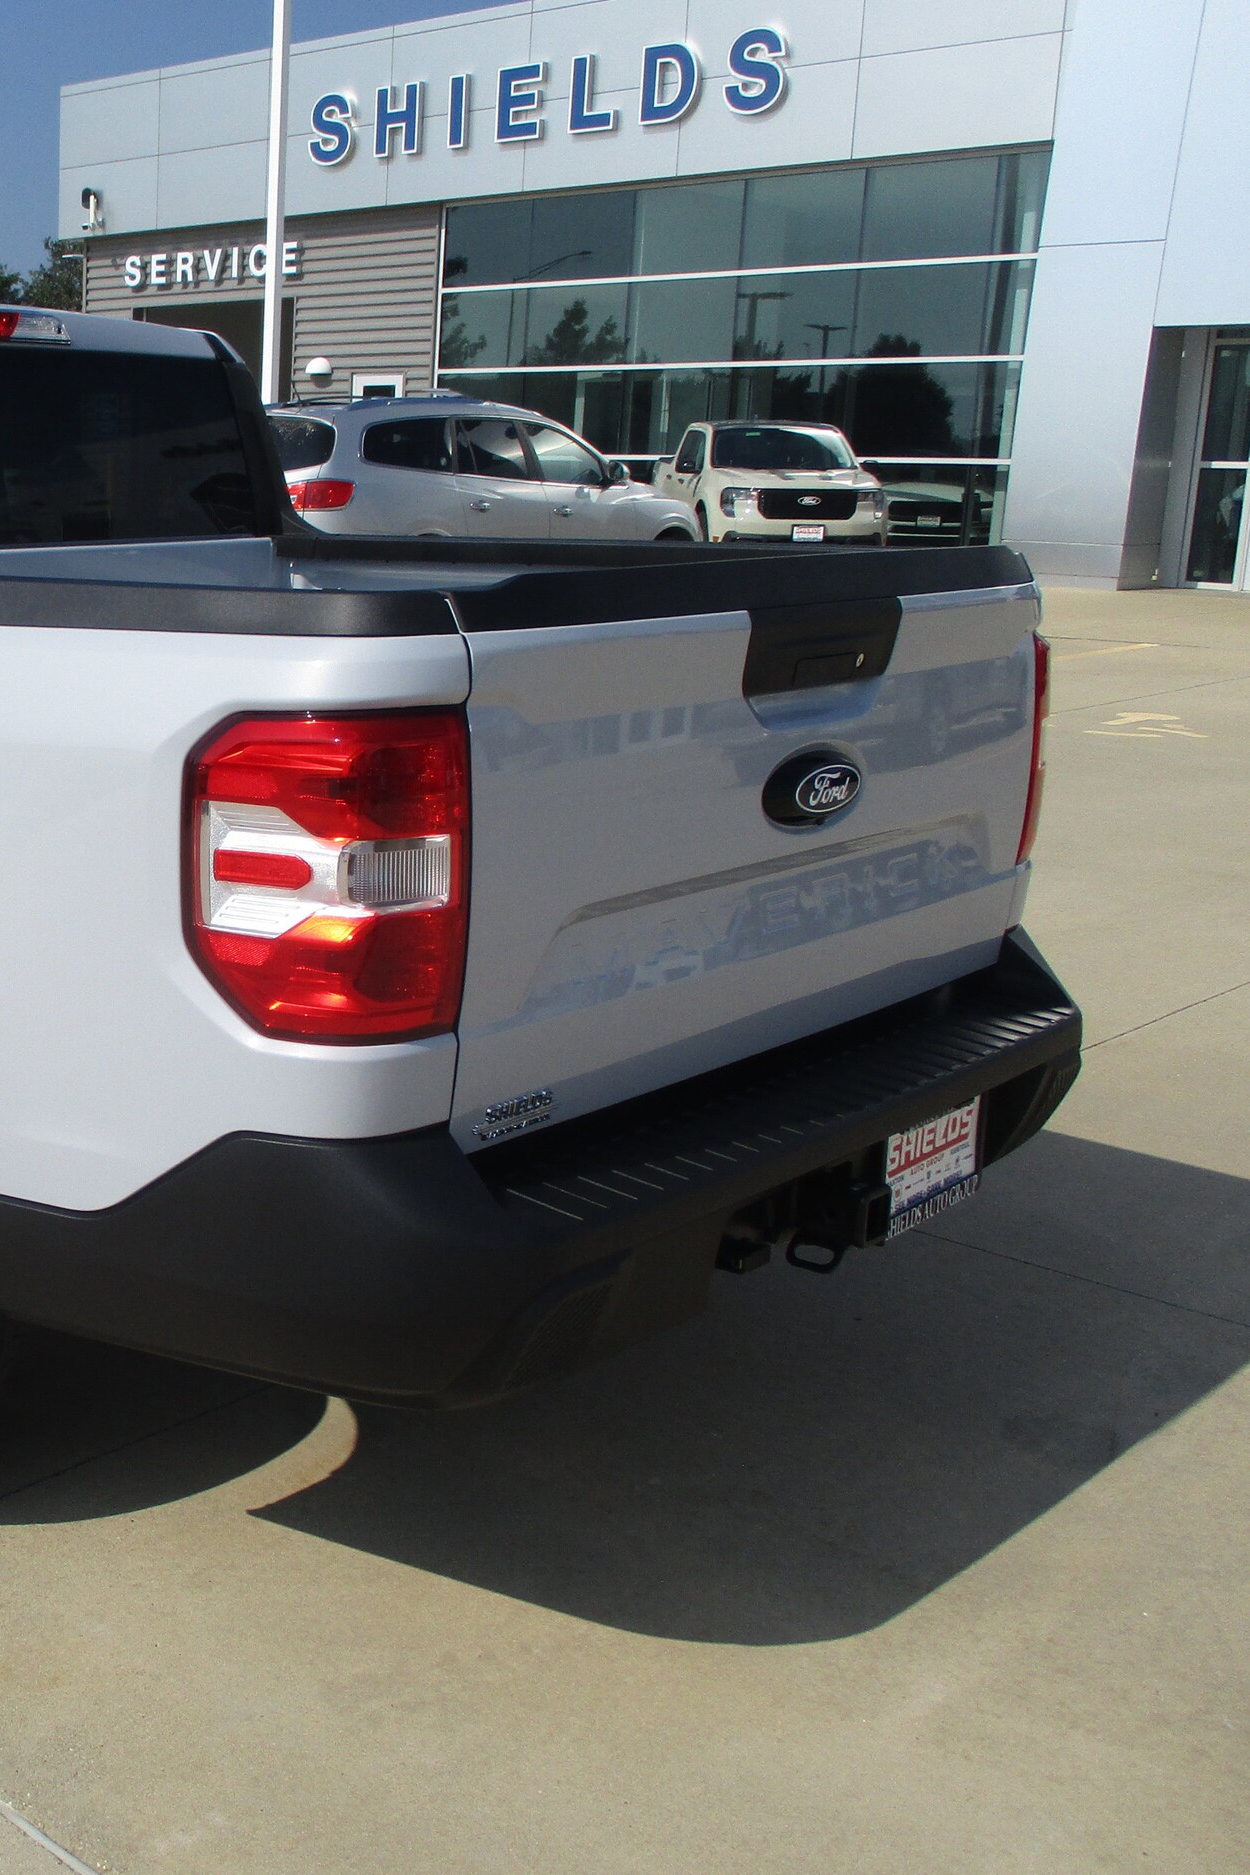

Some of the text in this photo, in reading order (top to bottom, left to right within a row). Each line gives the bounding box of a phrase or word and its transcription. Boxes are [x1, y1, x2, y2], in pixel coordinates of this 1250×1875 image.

[307, 26, 788, 167] SHIELDS
[124, 241, 298, 288] SERVICE
[808, 771, 850, 807] Ford
[887, 1108, 975, 1171] SHIELDS
[922, 1190, 948, 1221] AUTO
[948, 1174, 979, 1206] GROUP
